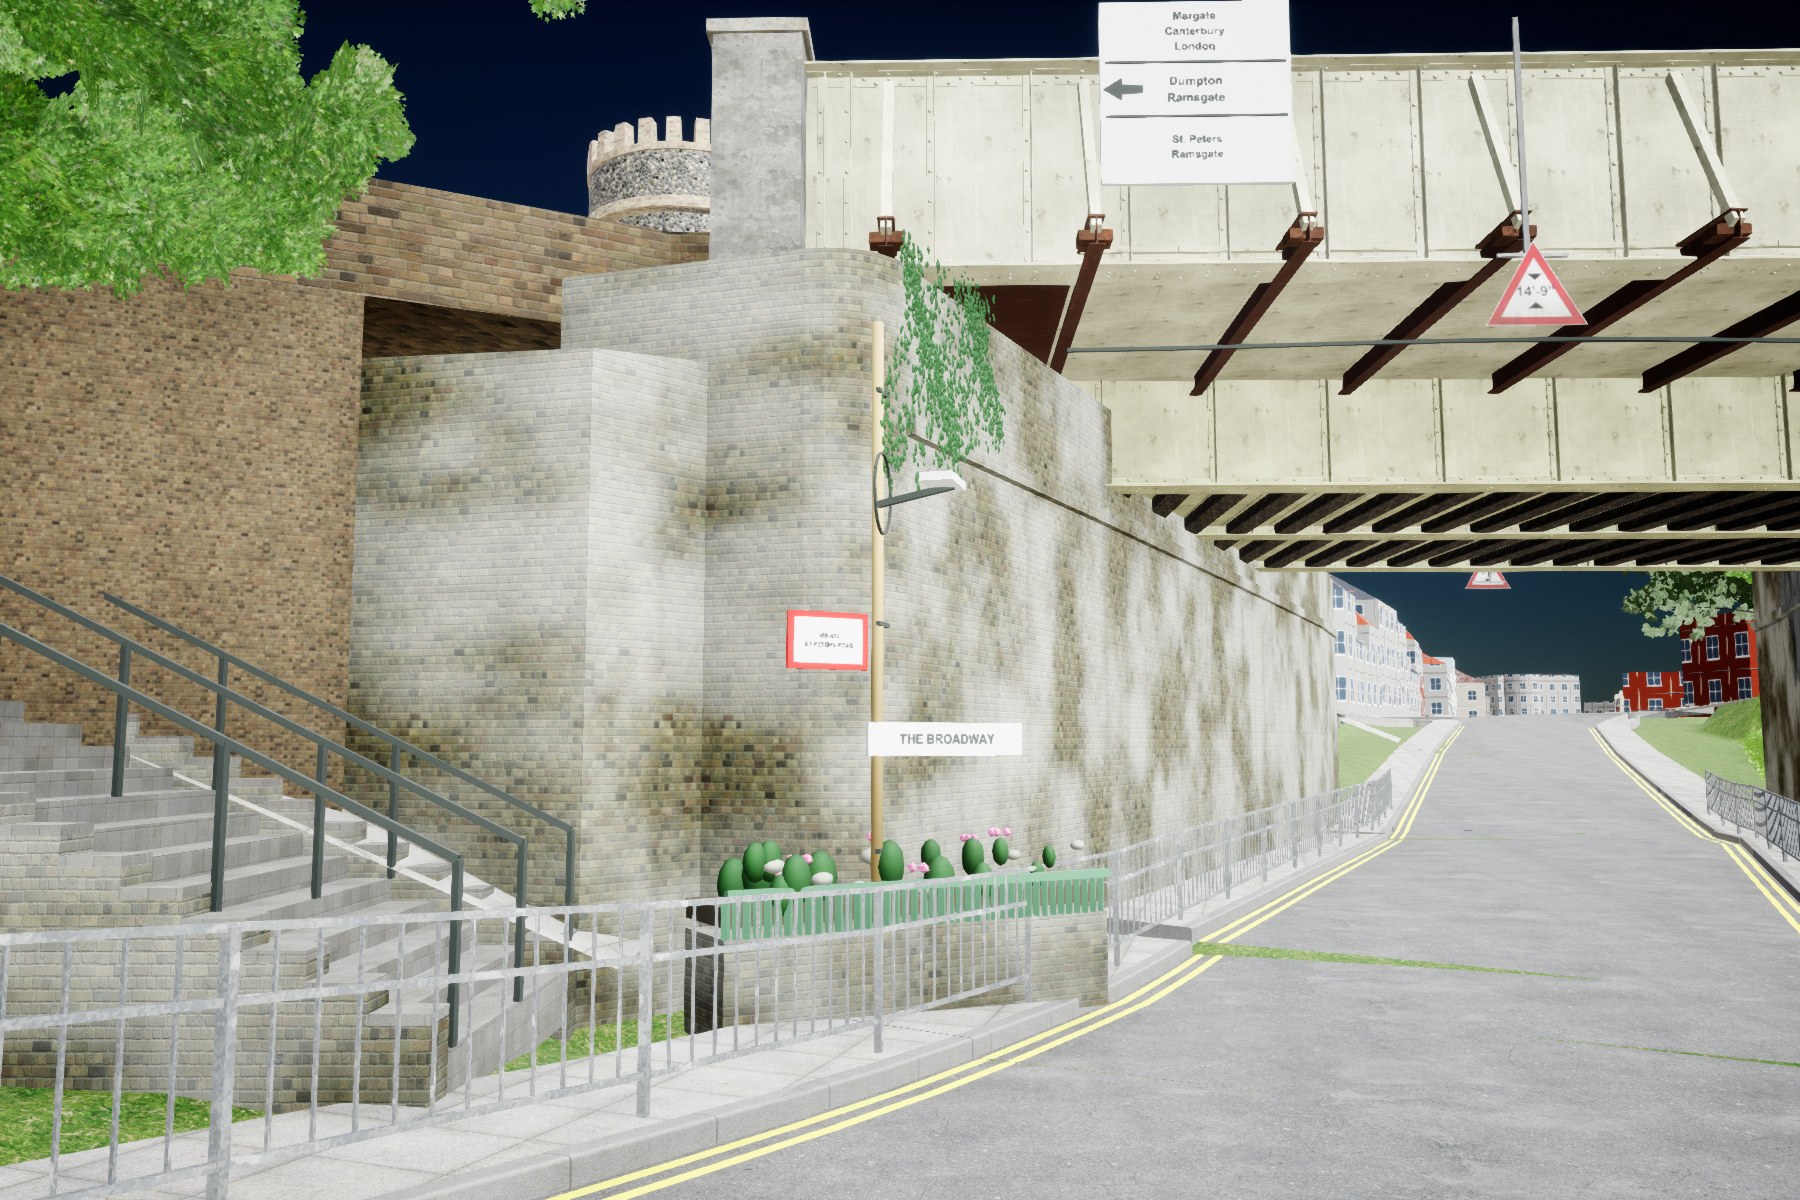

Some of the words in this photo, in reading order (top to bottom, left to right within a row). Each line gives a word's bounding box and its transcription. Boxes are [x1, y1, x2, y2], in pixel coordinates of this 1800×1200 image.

[1172, 11, 1216, 22] Margate
[1164, 26, 1225, 37] Canterbury
[1174, 41, 1216, 51] London
[1169, 76, 1223, 87] Dumpton
[1167, 92, 1226, 104] Ramsgate
[1172, 134, 1186, 144] St.
[1189, 134, 1223, 144] Peters
[1171, 149, 1224, 160] Ramsgate
[900, 733, 923, 745] THE
[926, 733, 995, 745] BROADWAY
